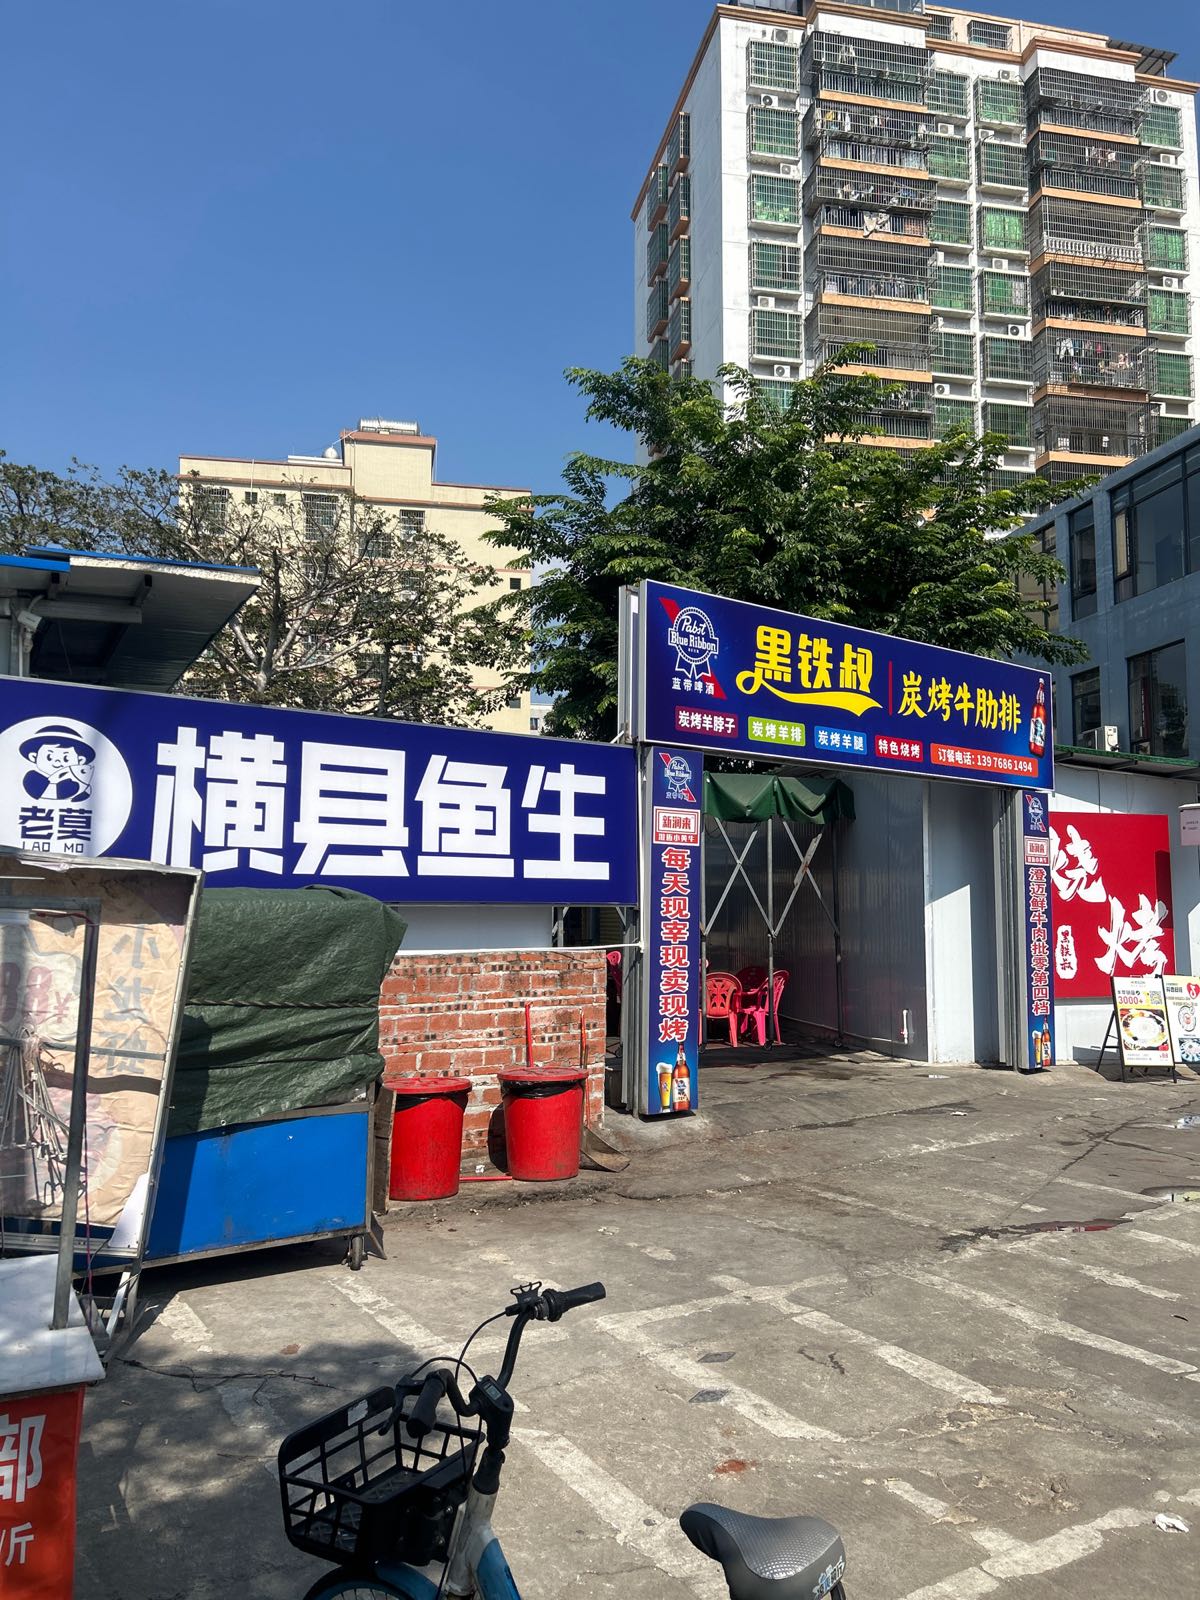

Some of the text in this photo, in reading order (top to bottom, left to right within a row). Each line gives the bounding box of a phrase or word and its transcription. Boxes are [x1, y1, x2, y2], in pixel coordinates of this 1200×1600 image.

[681, 615, 707, 636] Pabst
[670, 631, 717, 653] Blue Ribbon
[745, 624, 876, 698] 黑铁叔
[671, 676, 715, 696] 蓝带啤酒
[898, 670, 1022, 734] 炭烤牛肋排
[677, 710, 736, 734] 炭烤羊脖子
[751, 721, 802, 743] 炭烤羊排
[817, 730, 865, 751] 炭烤羊腿
[877, 738, 920, 760] 特色烧烤
[150, 725, 610, 881] 横县鱼生
[18, 805, 93, 842] 老莫
[63, 843, 84, 854] MO
[1049, 824, 1169, 978] 烧烤
[659, 847, 692, 1043] 每天现宰现卖现烤
[1028, 867, 1051, 1017] 澄迈鲜牛肉批零第四档
[1059, 930, 1075, 972] 黑铁叔
